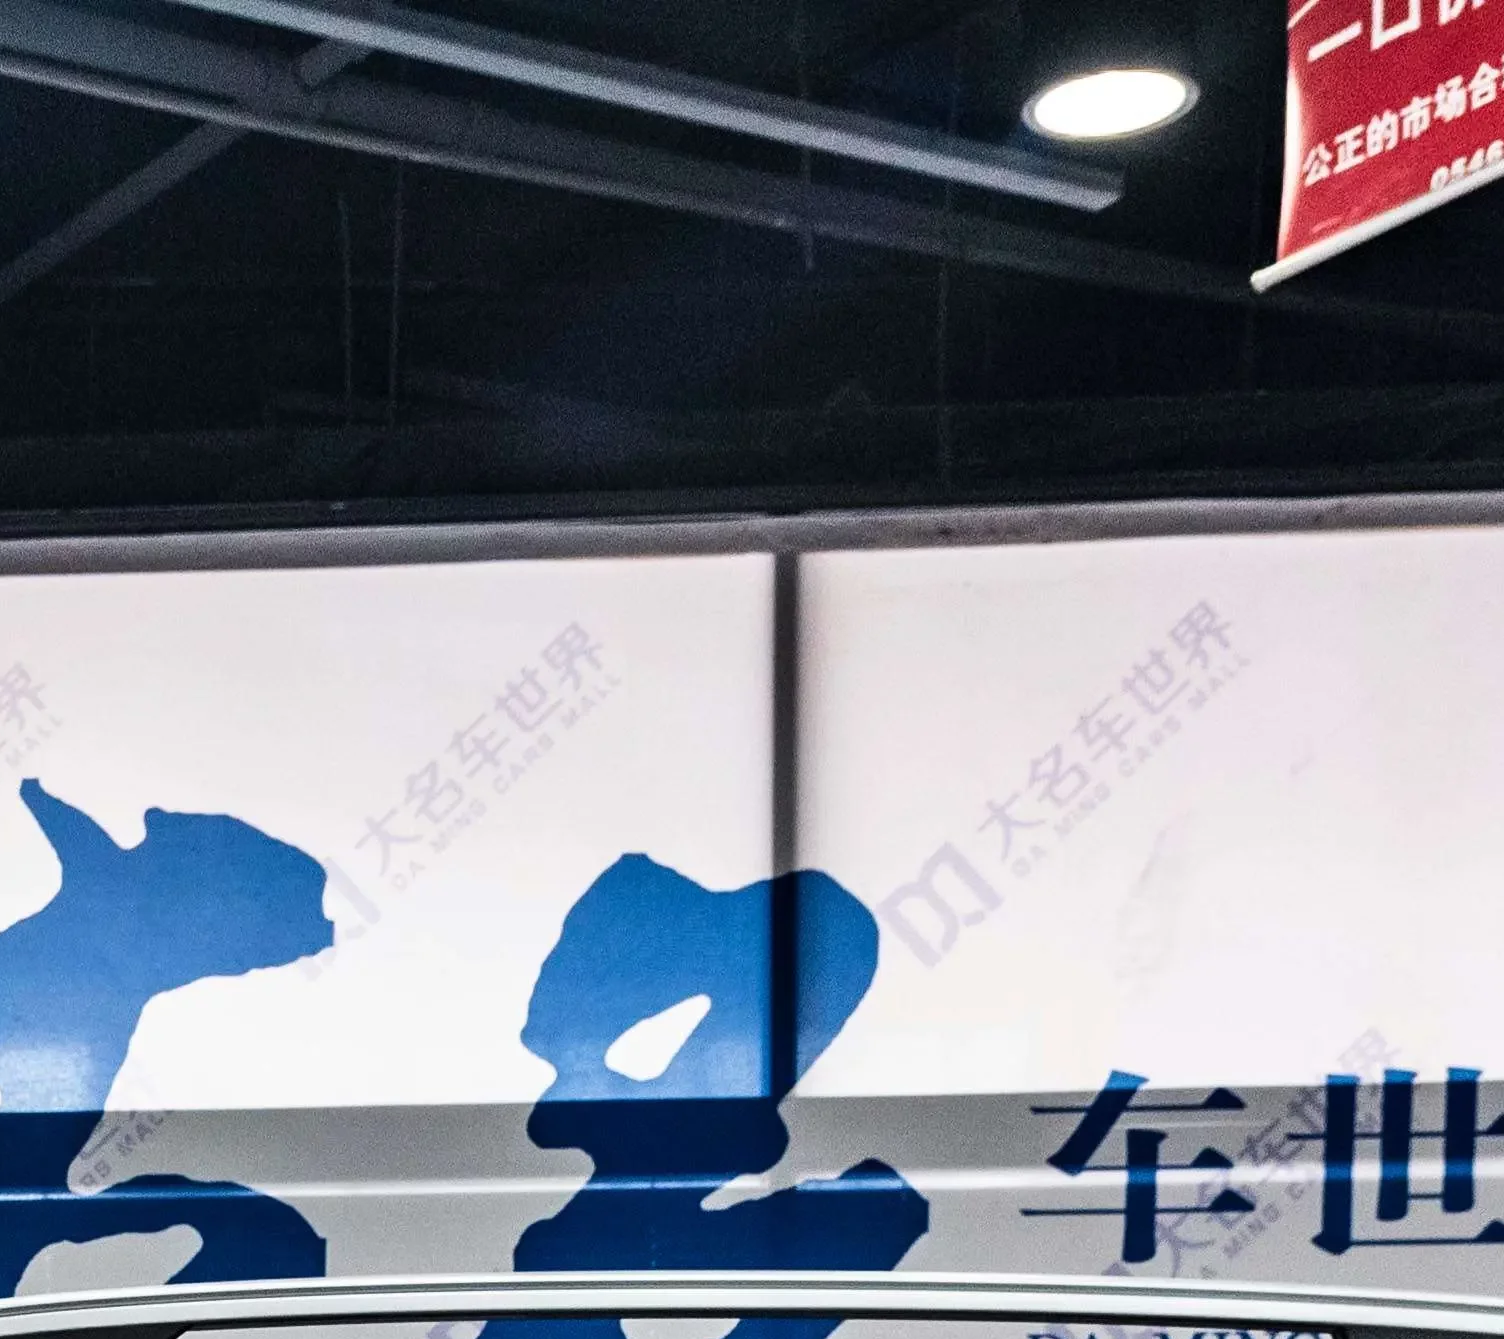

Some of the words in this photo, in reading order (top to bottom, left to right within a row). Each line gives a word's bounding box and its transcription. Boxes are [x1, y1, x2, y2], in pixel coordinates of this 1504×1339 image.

[357, 625, 605, 875] 大名车世界
[978, 604, 1233, 860] 大名车世界
